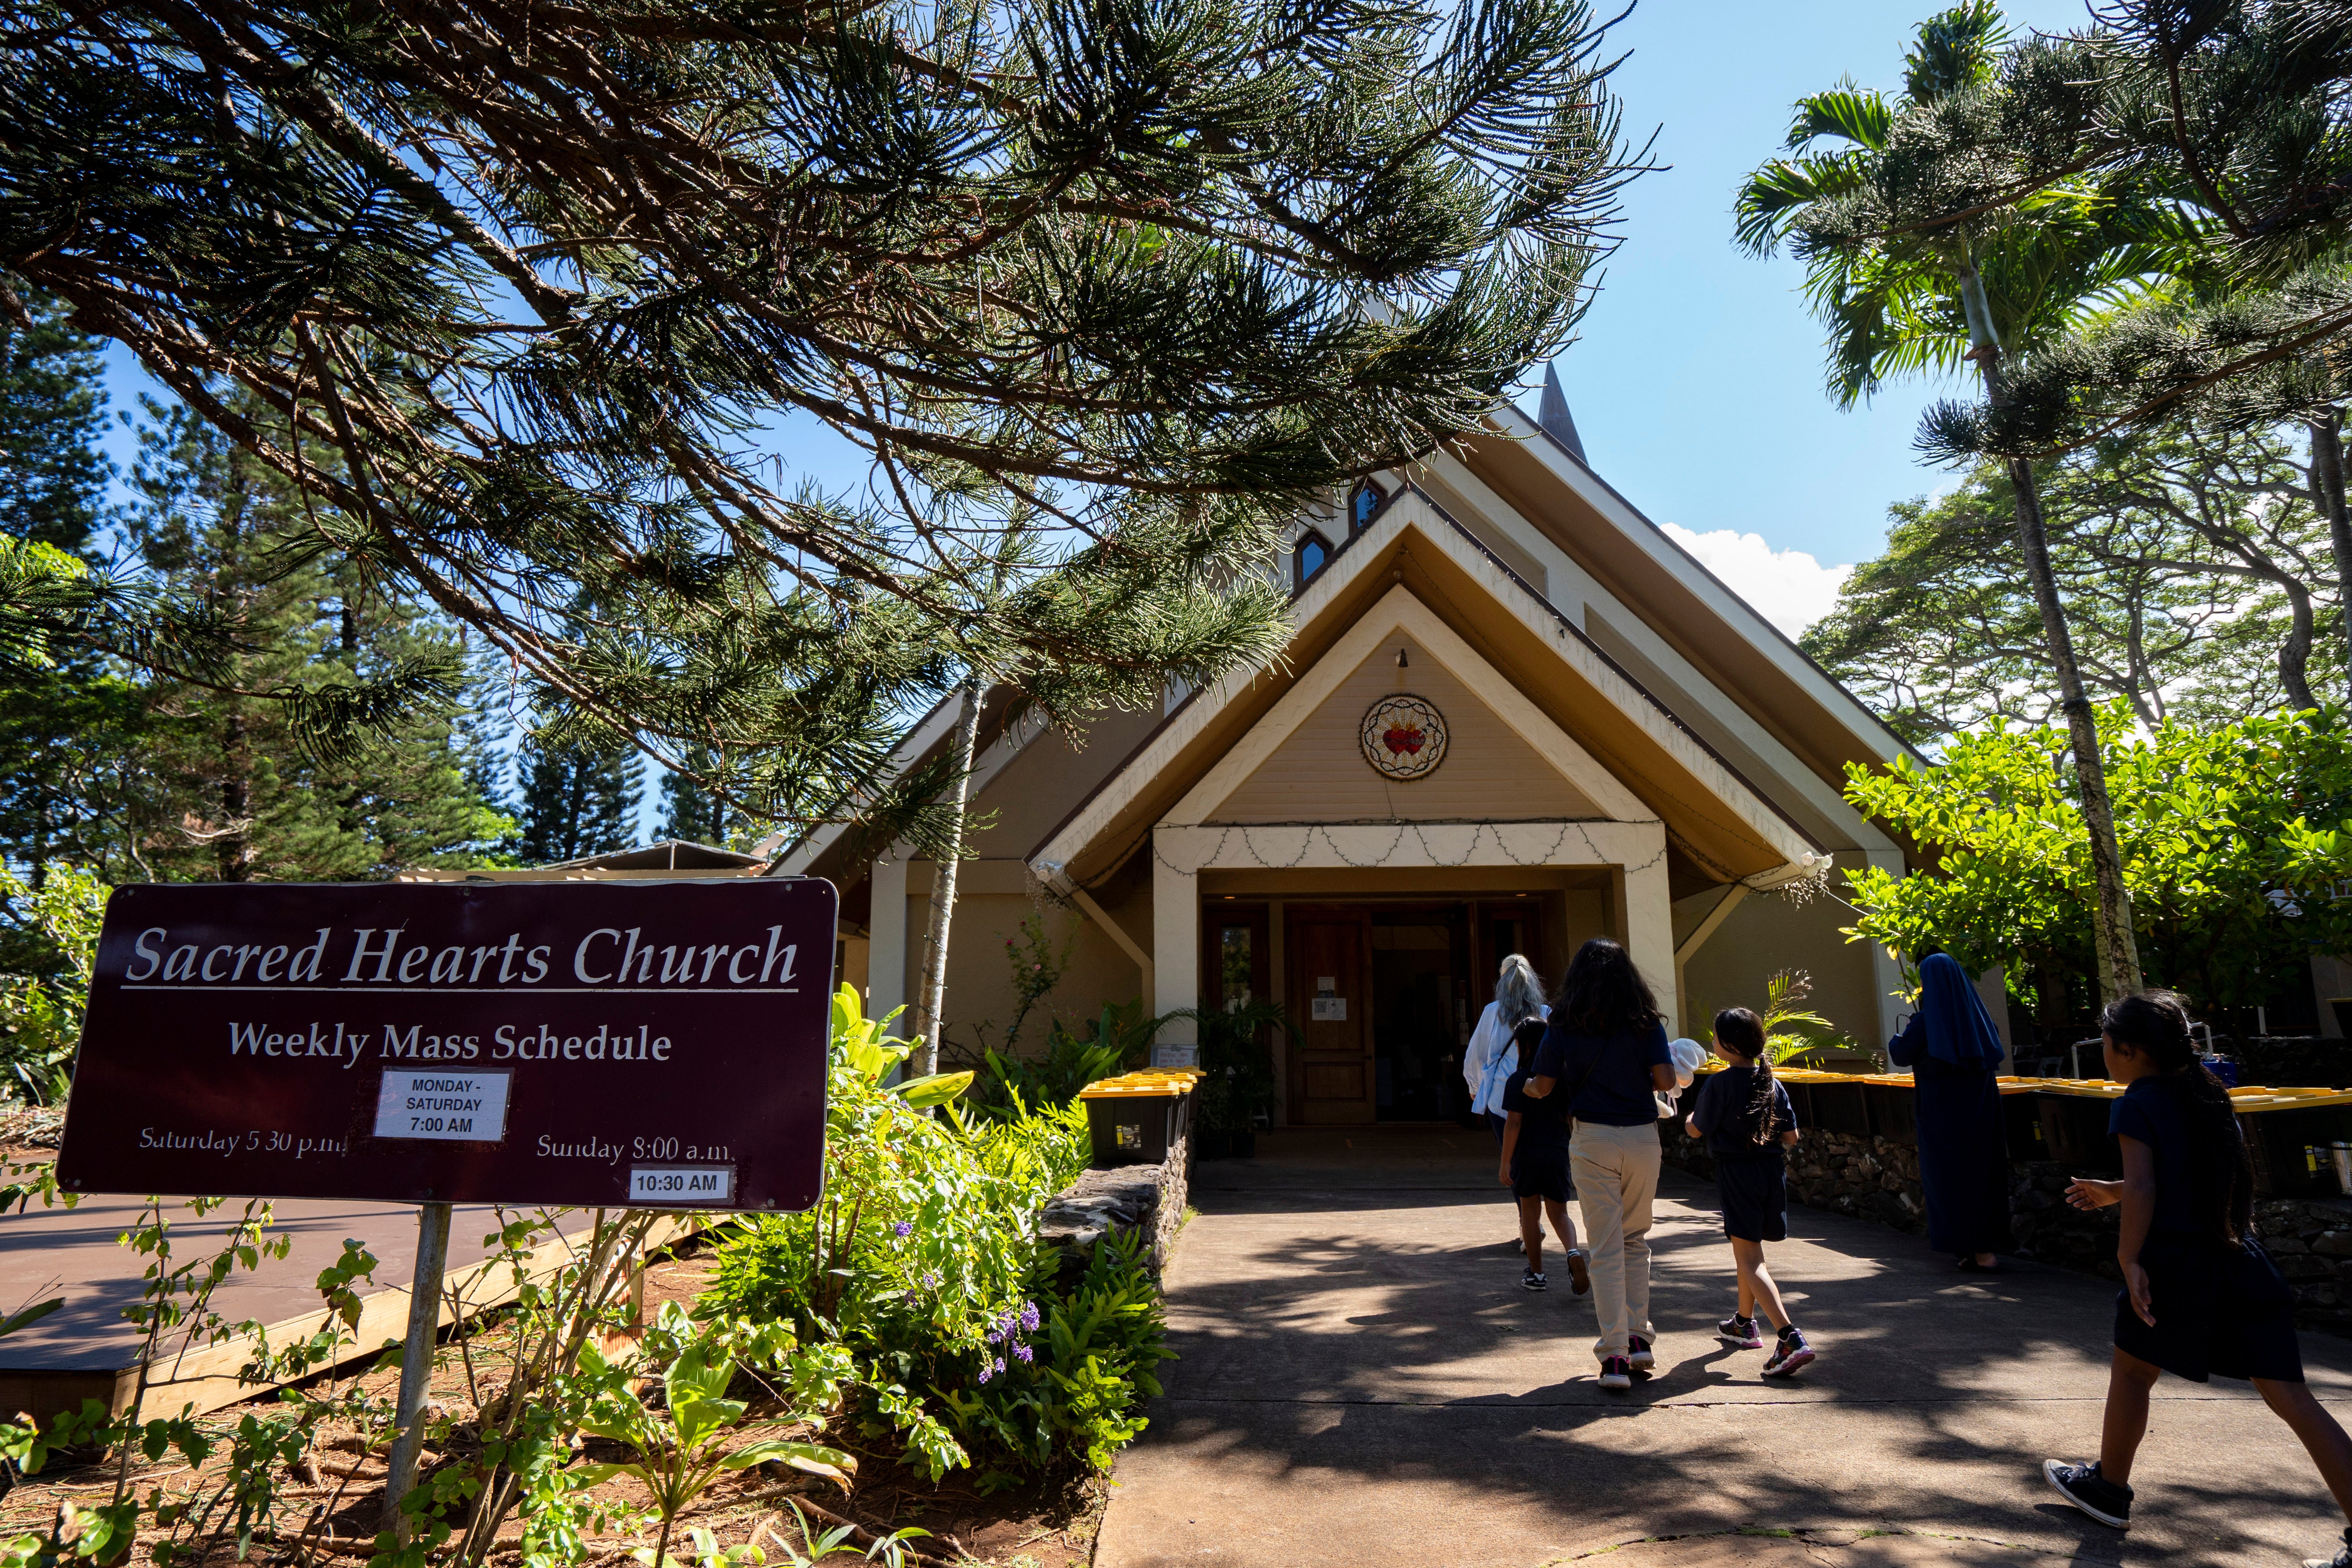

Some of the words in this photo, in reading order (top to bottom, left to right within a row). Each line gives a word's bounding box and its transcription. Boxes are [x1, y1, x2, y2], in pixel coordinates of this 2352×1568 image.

[126, 927, 331, 982] Sacred
[340, 928, 551, 983] Hearts
[574, 925, 797, 984] Church
[229, 1022, 370, 1069] Weekly
[379, 1024, 479, 1059] Mass
[493, 1024, 672, 1061] Schedule
[412, 1079, 473, 1092] MONDAY
[406, 1097, 482, 1112] SATURDAY
[411, 1117, 443, 1132] 7:00
[446, 1118, 473, 1133] AM
[139, 1127, 240, 1157] Saturday
[537, 1135, 625, 1166] Sunday
[633, 1136, 679, 1160] 8:00
[686, 1145, 736, 1162] a.m.
[637, 1175, 683, 1191] 10:30
[688, 1175, 717, 1191] AM
